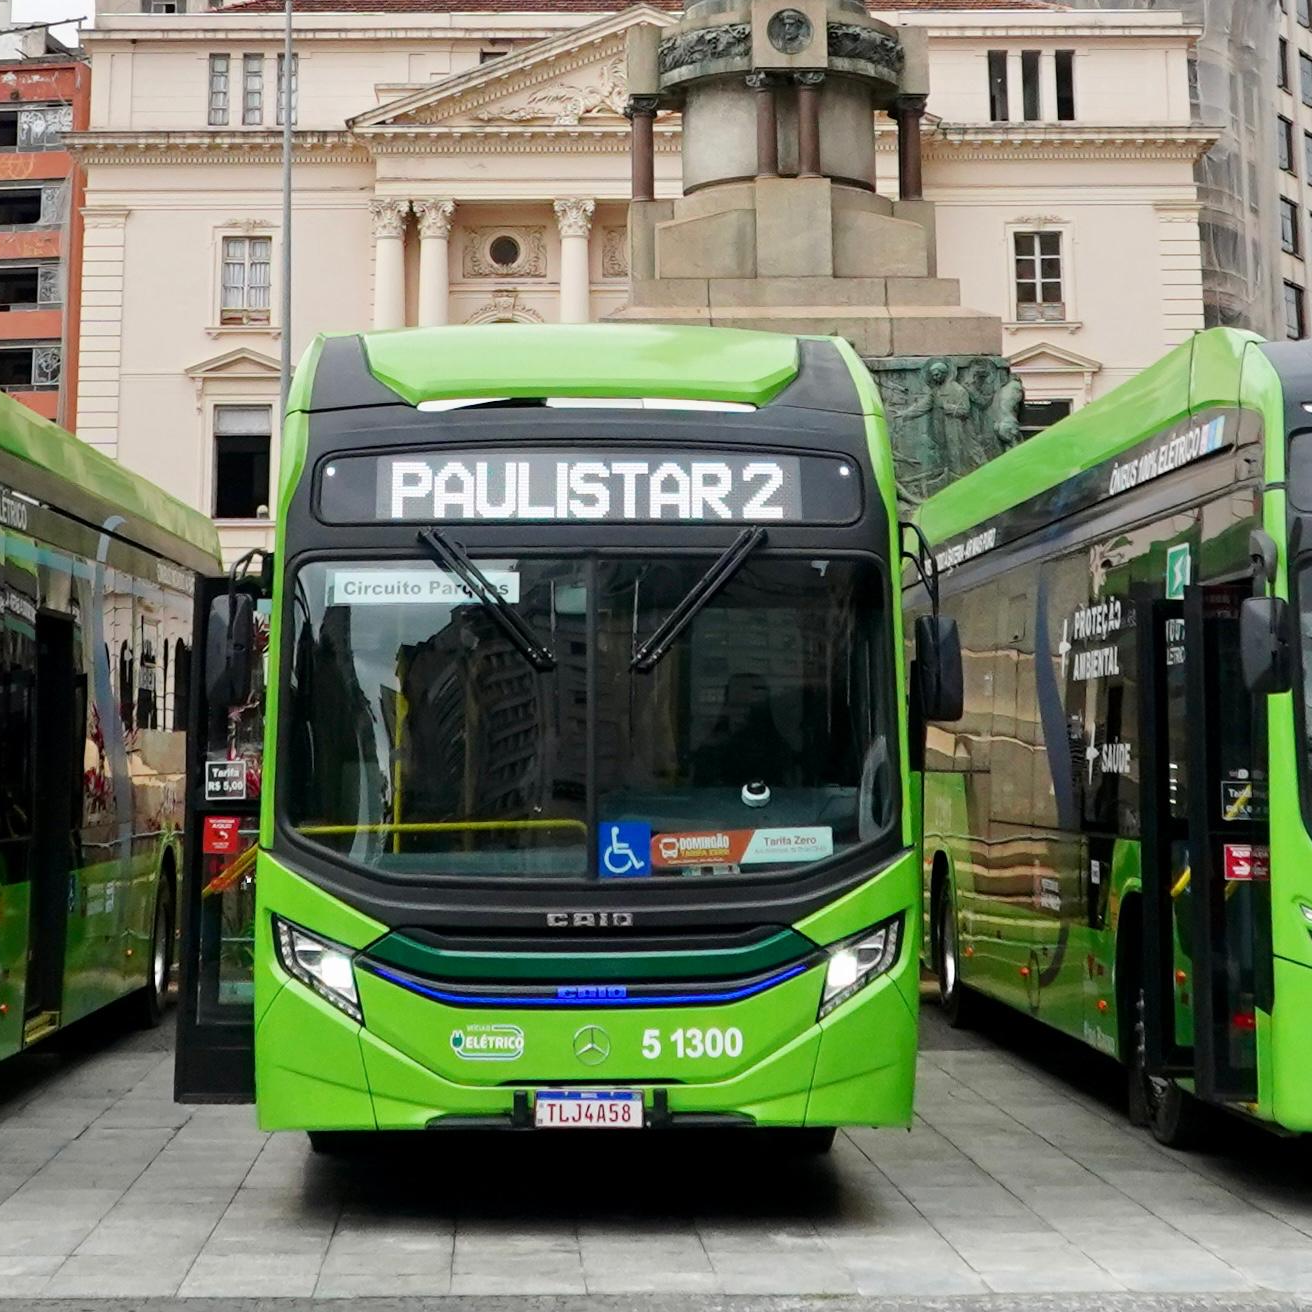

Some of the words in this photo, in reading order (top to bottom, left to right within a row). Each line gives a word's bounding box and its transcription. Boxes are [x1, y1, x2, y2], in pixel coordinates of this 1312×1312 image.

[391, 461, 732, 520] PAULISTAR
[742, 461, 784, 519] 2
[342, 579, 422, 596] Circuito
[428, 579, 510, 599] Parqs
[1074, 596, 1122, 641] PROTEÇÃO
[1073, 645, 1120, 682] AMBIENTAL
[1101, 736, 1132, 773] SAÚDE
[211, 768, 240, 778] Tarifa
[208, 780, 222, 791] R$
[763, 836, 793, 848] Tarifa
[794, 834, 817, 846] Zero
[546, 912, 634, 927] CAIO
[464, 1032, 525, 1050] ELÉTRICO
[641, 1028, 662, 1060] 5
[670, 1026, 745, 1059] 1300
[546, 1102, 633, 1124] TLJ4A58
